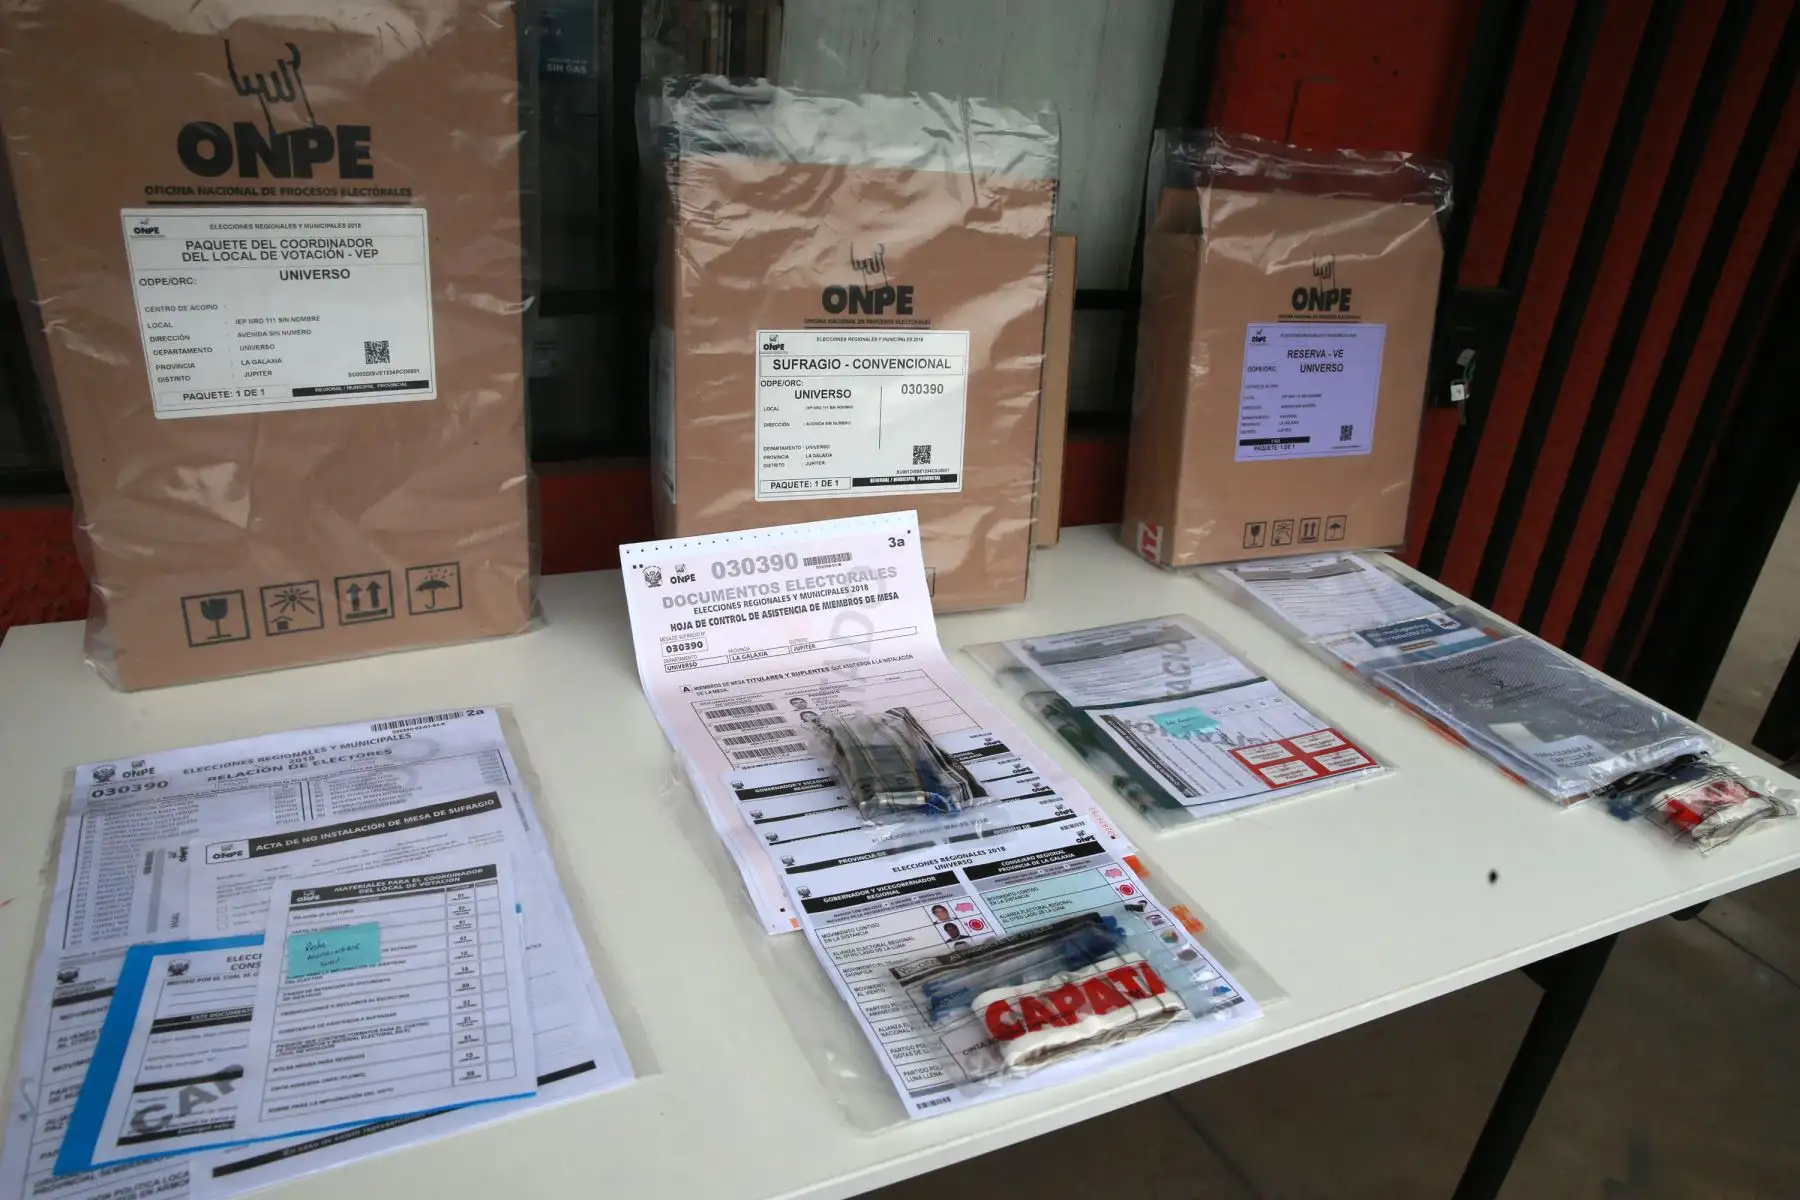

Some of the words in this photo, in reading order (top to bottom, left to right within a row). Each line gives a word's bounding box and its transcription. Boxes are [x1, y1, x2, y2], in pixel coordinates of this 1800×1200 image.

[177, 120, 374, 179] ONPE
[145, 185, 194, 196] OFICINA
[197, 185, 258, 196] NACIONAL
[261, 187, 277, 196] DE
[280, 186, 338, 197] PROCESOS
[133, 227, 160, 235] ONPE
[186, 239, 247, 250] PAQUETE
[251, 239, 276, 249] DEL
[280, 238, 374, 249] COORDINADOR
[182, 251, 209, 262] DEL
[212, 251, 257, 261] LOCAL
[260, 250, 278, 261] DE
[281, 245, 344, 260] VOTACIÓN
[355, 248, 379, 259] VEP
[279, 268, 351, 281] UNIVERSO
[139, 277, 197, 287] ODPE/ORC:
[821, 285, 914, 315] ONPE
[1291, 287, 1352, 312] ONPE
[145, 305, 176, 313] CENTRO
[190, 304, 218, 312] ACOPIO
[150, 333, 190, 342] DIRECCIÓN
[153, 347, 213, 356] DEPARTAMENTO
[763, 343, 785, 351] ONPE
[1287, 349, 1326, 359] RESERVA
[1333, 348, 1344, 358] VE
[155, 362, 195, 370] PROVINCIA
[773, 359, 841, 370] SUFRAGIO
[852, 358, 951, 370] CONVENCIONAL
[1300, 363, 1344, 373] UNIVERSO
[158, 375, 191, 383] DISTRITO
[244, 370, 272, 378] JUPITER
[760, 379, 803, 387] ODPE/ORC:
[795, 389, 851, 400] UNIVERSO
[901, 384, 944, 394] 030390
[183, 390, 233, 401] PAQUETE:
[236, 389, 241, 397] 1
[770, 480, 812, 490] PAQUETE:
[888, 536, 906, 548] 3a
[711, 551, 798, 579] 030390
[670, 573, 696, 584] ONPE
[661, 581, 780, 609] DOCUMENTOS
[785, 566, 898, 592] ELECTORALES
[693, 601, 741, 615] ELECCIONES
[743, 594, 791, 608] REGIONALES
[792, 593, 798, 601] Y
[800, 586, 850, 600] MUNICIPALES
[851, 583, 869, 593] 2018
[670, 621, 694, 632] HOJA
[695, 619, 707, 629] DE
[708, 613, 747, 627] CONTROL
[748, 611, 760, 620] DE
[761, 604, 808, 618] ASISTENCIA
[809, 602, 821, 612] DE
[822, 597, 863, 610] MIEMBROS
[864, 594, 876, 604] DE
[877, 591, 900, 602] MESA
[665, 640, 703, 654] 030390
[793, 643, 816, 652] JUPITER
[663, 654, 697, 664] DEPARTAMENTO
[741, 650, 768, 660] GALAXIA
[666, 661, 698, 671] UNIVERSO
[466, 708, 485, 717] 2a
[182, 759, 254, 775] ELECCIONES
[257, 746, 328, 763] REGIONALES
[340, 732, 412, 750] MUNICIPALES
[207, 764, 284, 782] RELACIÓN
[288, 762, 309, 770] DE
[312, 748, 393, 766] ELECTORES
[288, 755, 315, 764] 2018
[122, 767, 156, 779] ONPE
[1012, 764, 1031, 774] ONPE
[92, 781, 169, 798] 030390
[1031, 784, 1051, 793] ONPE
[1054, 808, 1074, 817] ONPE
[255, 842, 284, 852] ACTA
[302, 835, 318, 843] NO
[320, 821, 386, 840] INSTALACIÓN
[387, 818, 401, 827] DE
[403, 813, 431, 824] MESA
[433, 809, 446, 818] DE
[447, 798, 495, 814] SUFRAGIO
[1075, 834, 1096, 844] ONPE
[212, 850, 243, 860] ONPE
[892, 858, 937, 873] ELECCIONES
[939, 850, 987, 865] REGIONALES
[988, 846, 1006, 856] 2018
[1001, 855, 1036, 867] CONSEJERO
[1036, 849, 1067, 860] REGIONAL
[934, 858, 973, 871] UNIVERSO
[998, 861, 1032, 873] PROVINCIA
[1049, 853, 1076, 862] GALAXIA
[334, 880, 386, 892] MATERIALES
[388, 878, 410, 886] PARA
[423, 868, 484, 881] COORDINADOR
[376, 885, 404, 893] LOCAL
[420, 877, 460, 887] VOTACIÓN
[823, 890, 870, 904] GOBERNADOR
[876, 875, 937, 893] VICEGOBERNADOR
[866, 889, 900, 900] REGIONAL
[821, 927, 856, 939] MOVIMIENTO
[856, 922, 880, 932] CONTIGO
[841, 931, 869, 941] DISTANCIA
[832, 948, 855, 957] ALIANZA
[856, 941, 887, 952] ELECTORAL
[888, 936, 916, 946] REGIONAL
[230, 961, 261, 971] CONS
[865, 988, 886, 996] VIENTO
[865, 1003, 890, 1013] PARTIDO
[878, 1023, 902, 1032] ALIANZA
[880, 1028, 911, 1038] NACIONAL
[963, 1043, 986, 1056] CINTA
[903, 1067, 929, 1077] PARTIDO
[907, 1074, 924, 1083] LUNA
[924, 1071, 944, 1080] LLENA
